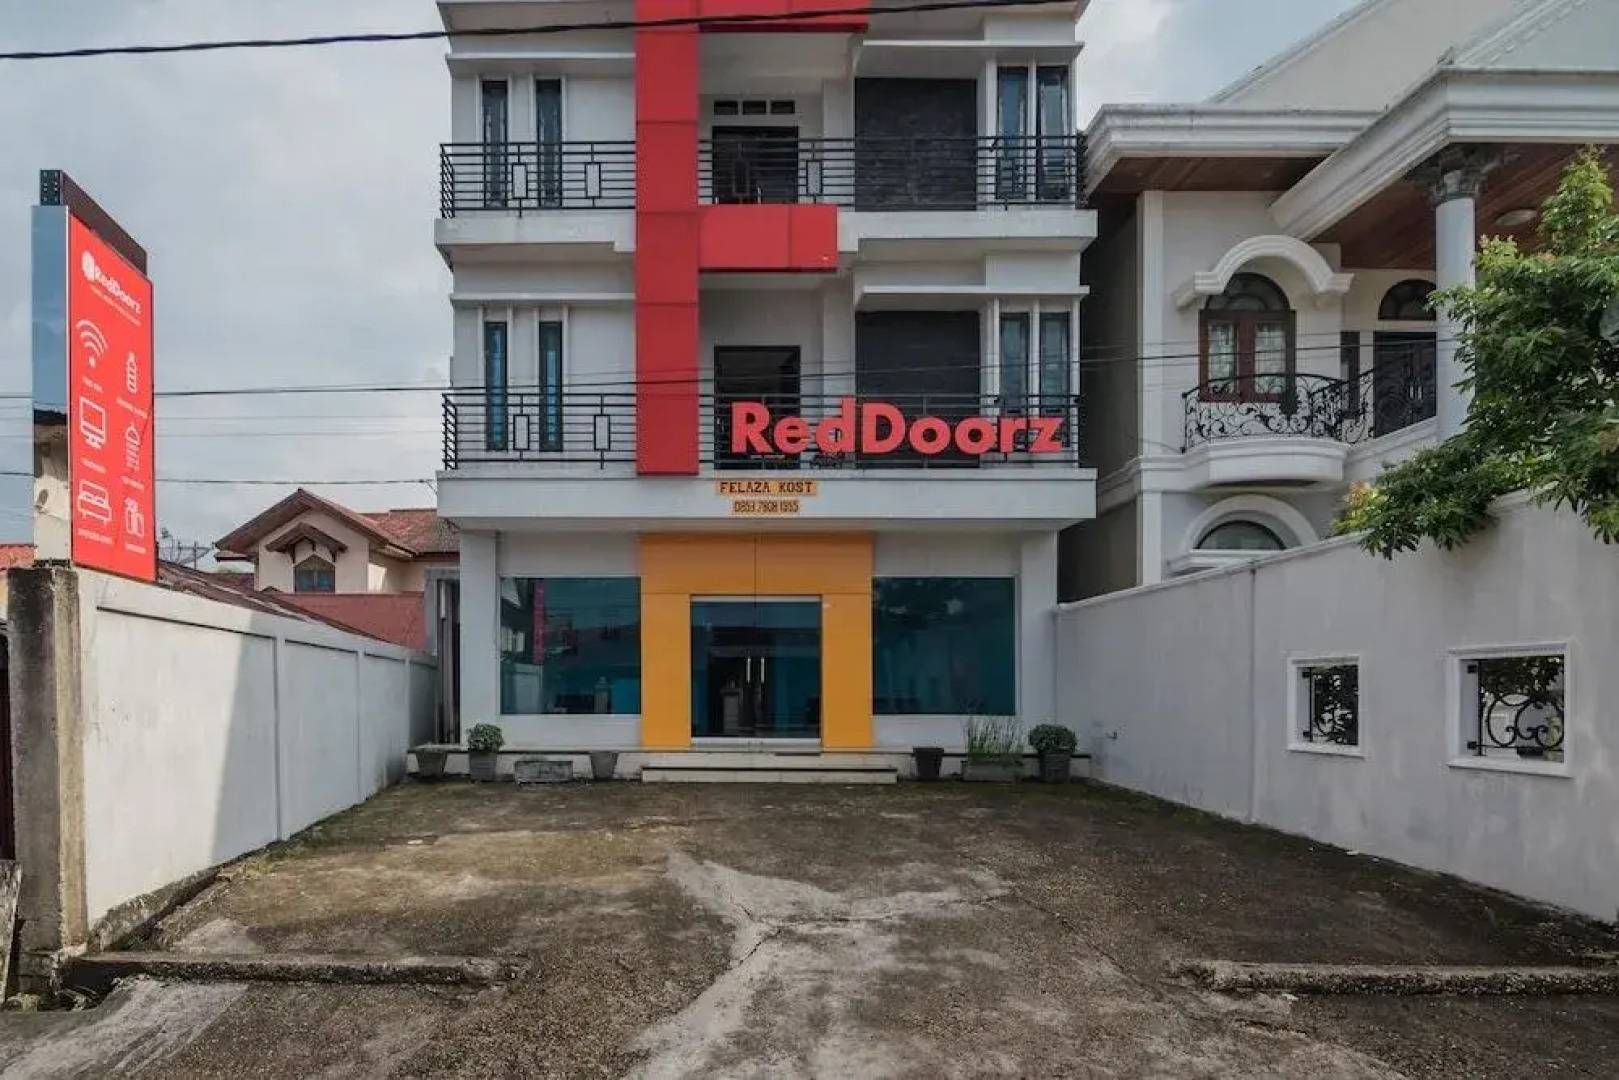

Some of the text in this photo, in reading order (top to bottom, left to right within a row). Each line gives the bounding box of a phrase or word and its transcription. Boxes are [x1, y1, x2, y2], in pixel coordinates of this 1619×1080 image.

[730, 395, 1064, 455] RedDoorz
[719, 481, 813, 493] FELAZA KOST
